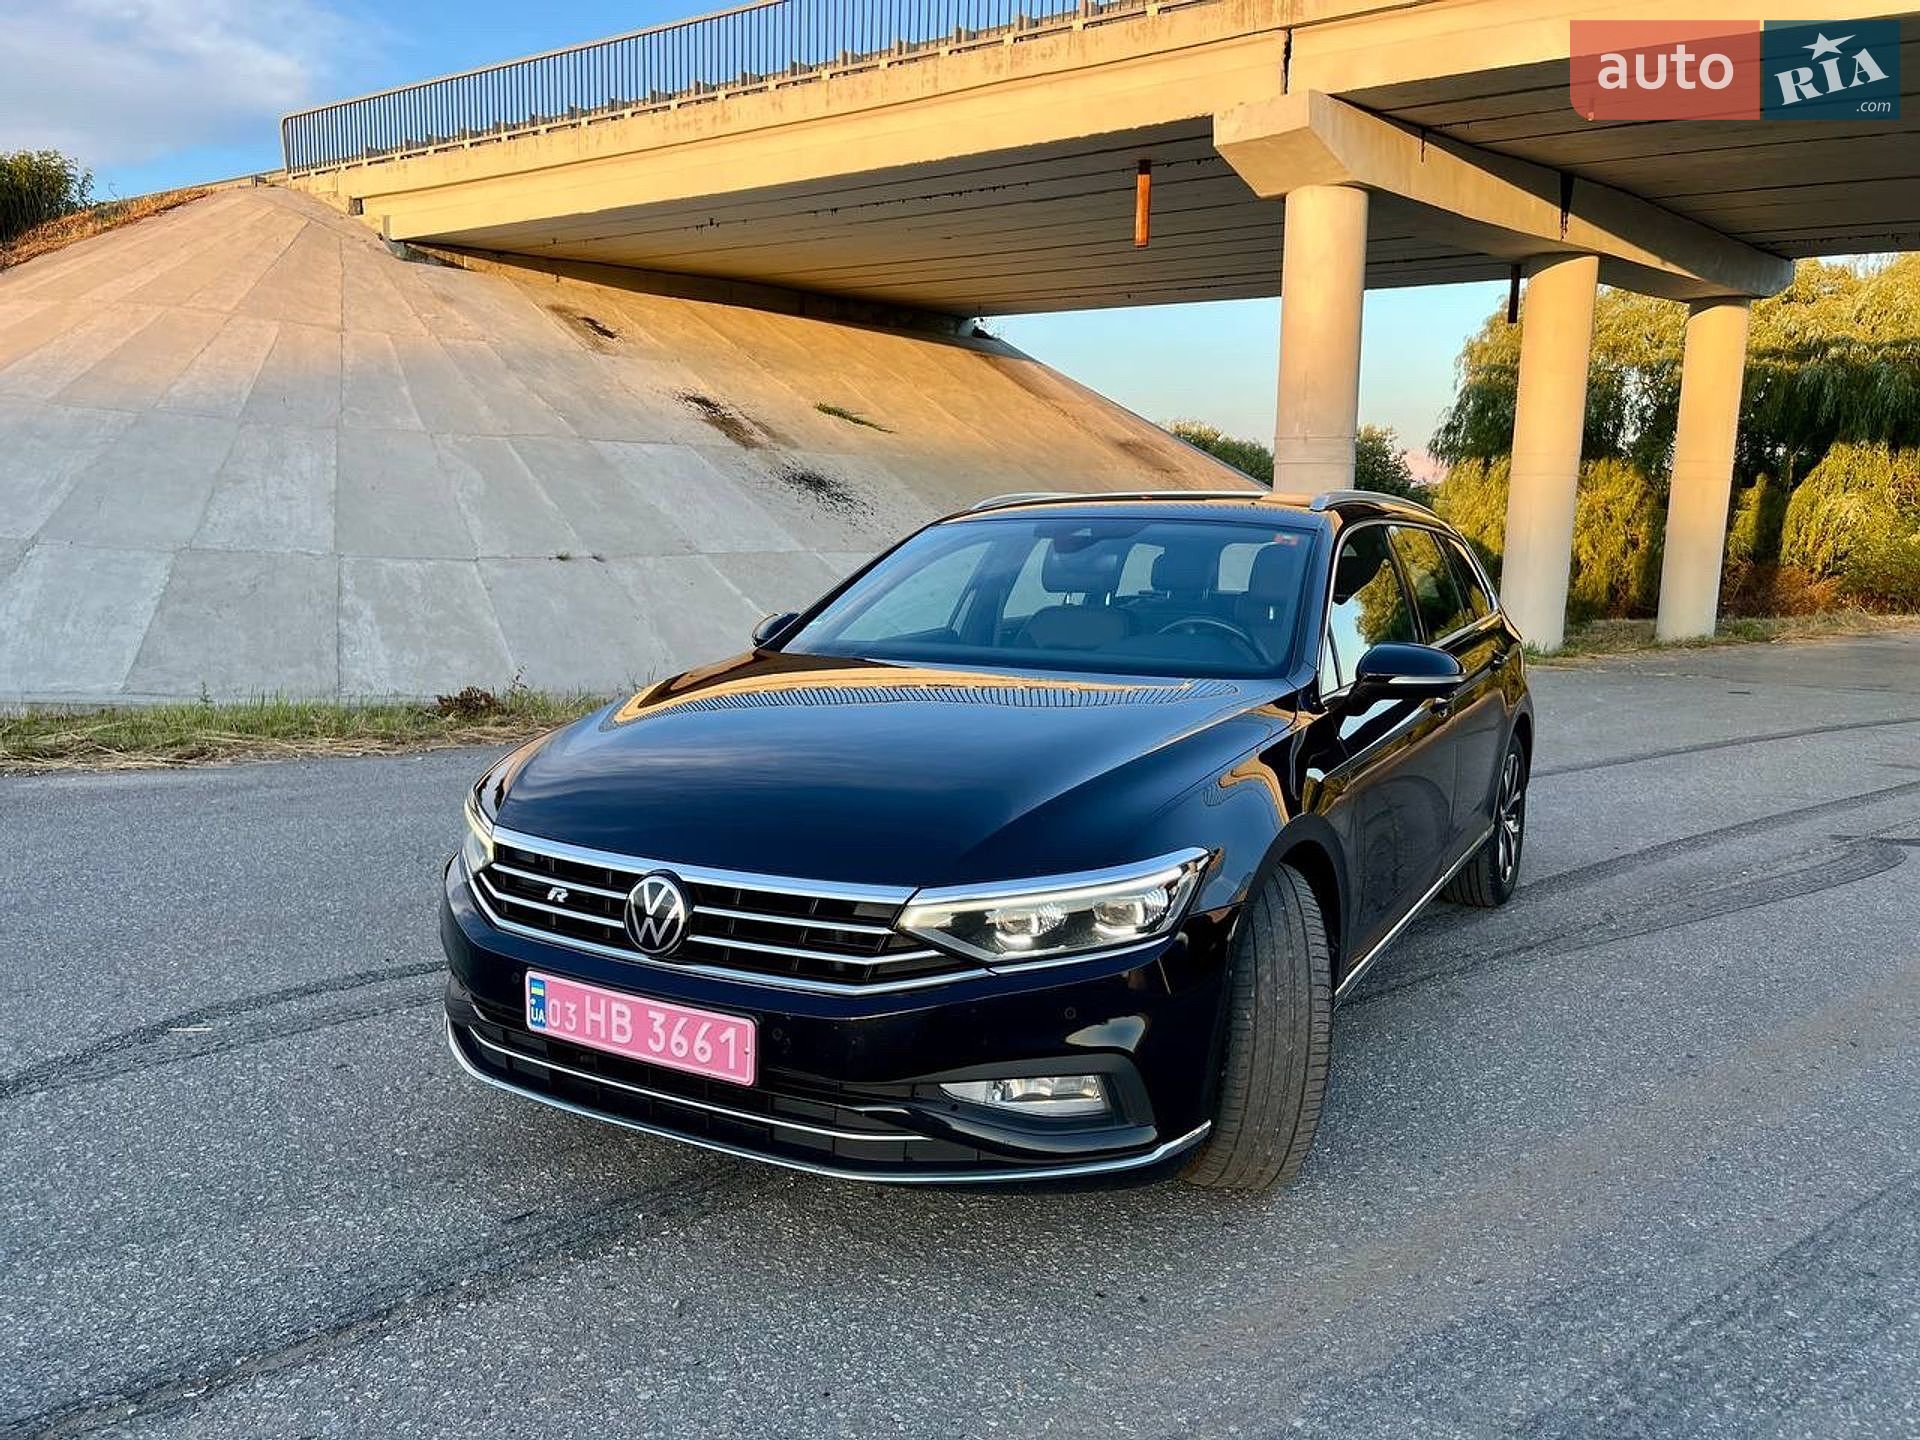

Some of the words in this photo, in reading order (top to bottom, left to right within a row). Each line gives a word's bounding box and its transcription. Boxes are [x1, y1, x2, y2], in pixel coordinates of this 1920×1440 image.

[530, 1007, 546, 1024] UA
[548, 998, 578, 1033] 03
[647, 1009, 737, 1071] 3661
